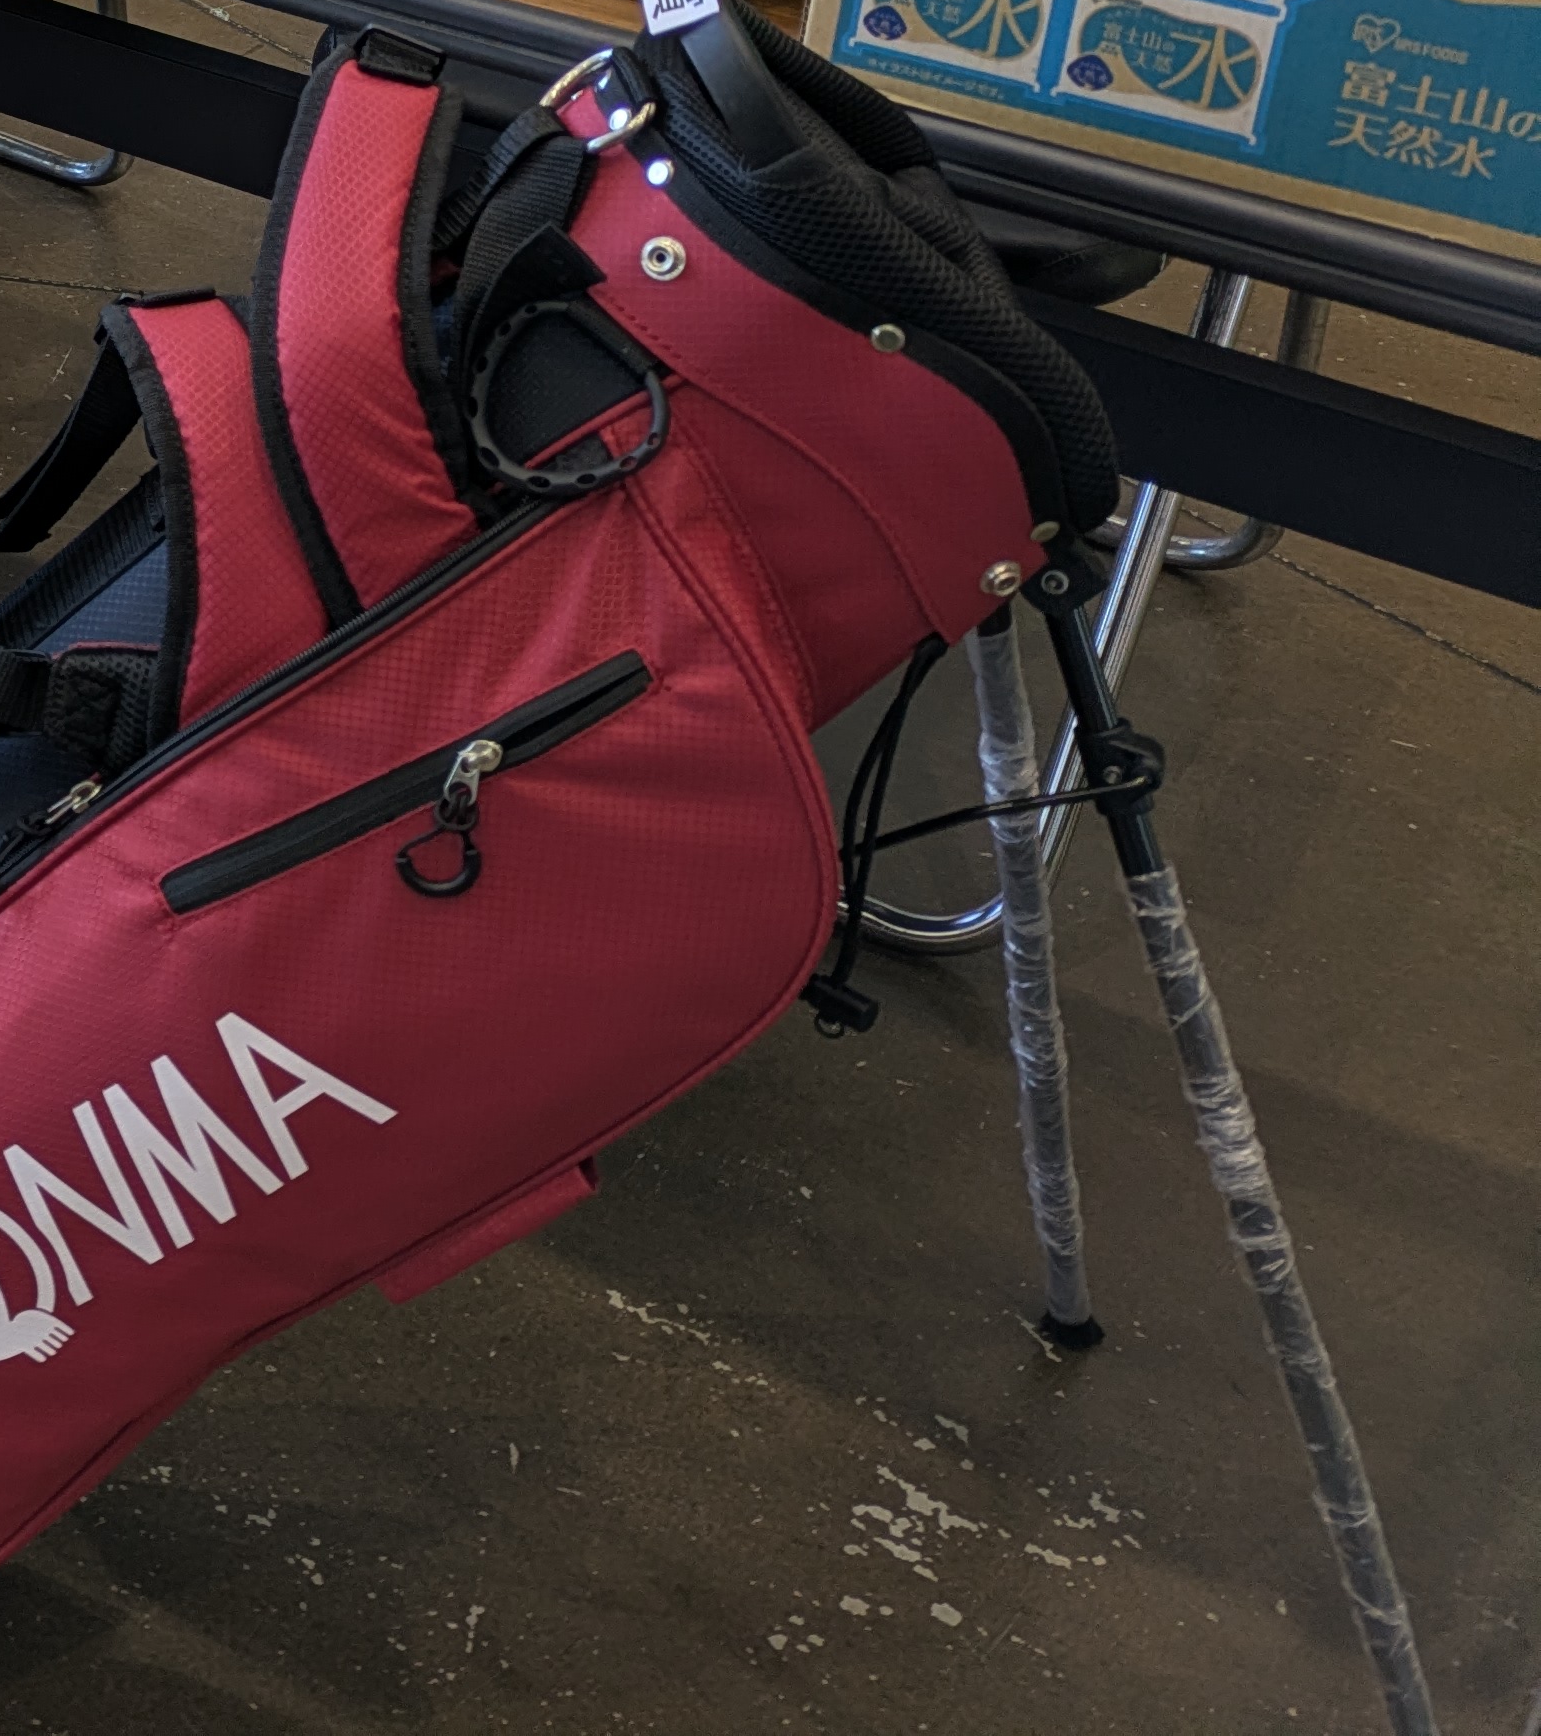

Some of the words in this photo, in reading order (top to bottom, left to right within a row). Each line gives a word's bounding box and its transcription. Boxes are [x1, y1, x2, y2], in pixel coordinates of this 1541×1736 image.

[1341, 59, 1541, 139] 富士山の
[1326, 105, 1498, 182] 天然水
